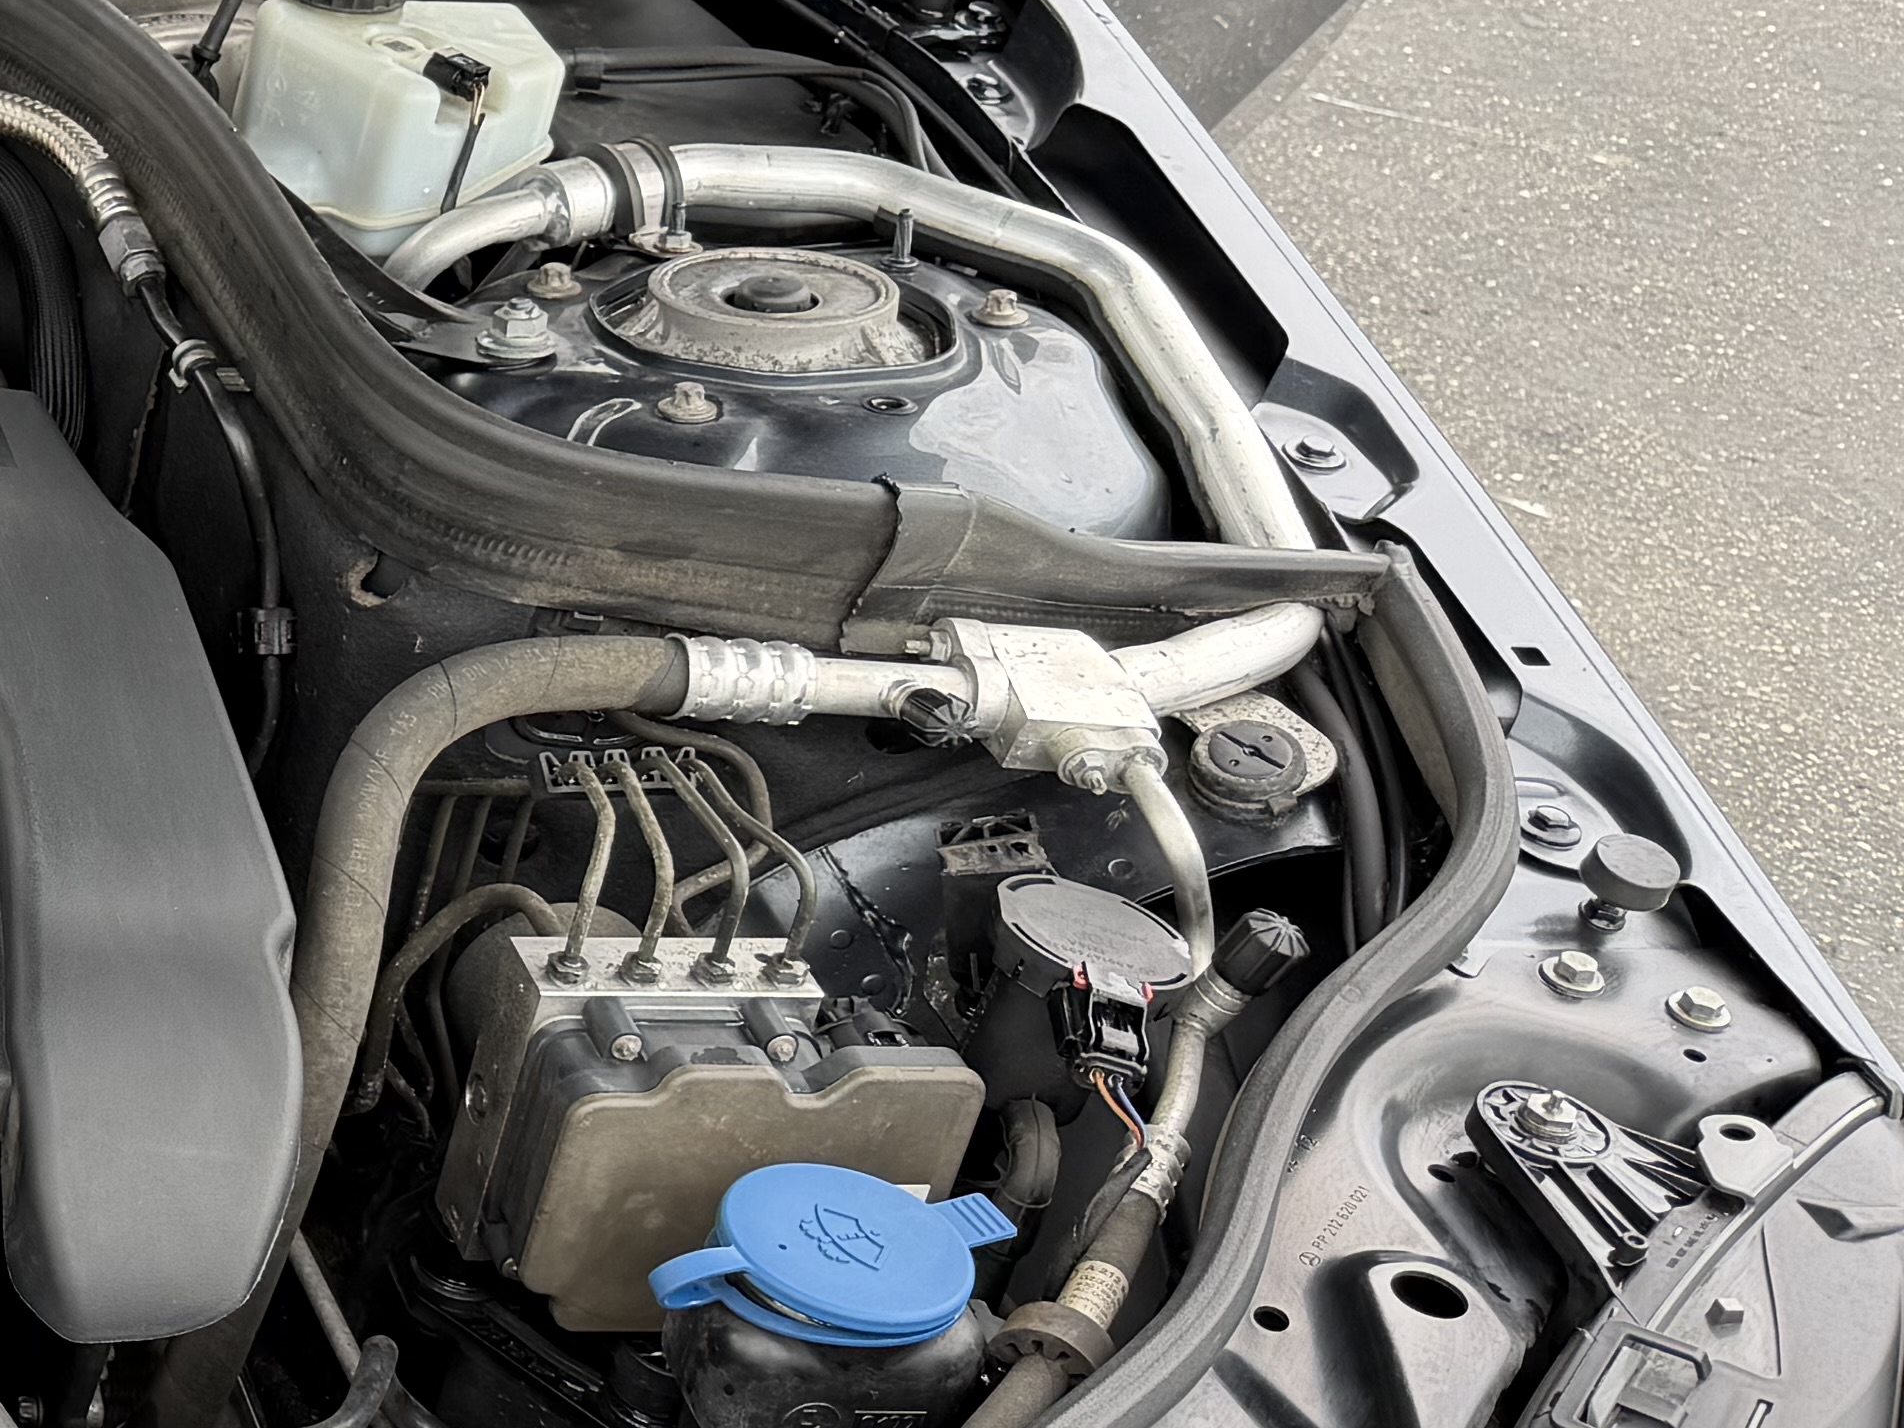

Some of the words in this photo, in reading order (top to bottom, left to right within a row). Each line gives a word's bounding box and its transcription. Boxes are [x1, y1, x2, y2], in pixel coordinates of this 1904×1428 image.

[1323, 1219, 1343, 1237] 212
[1339, 1201, 1357, 1221] 620
[1352, 1185, 1370, 1203] 021
